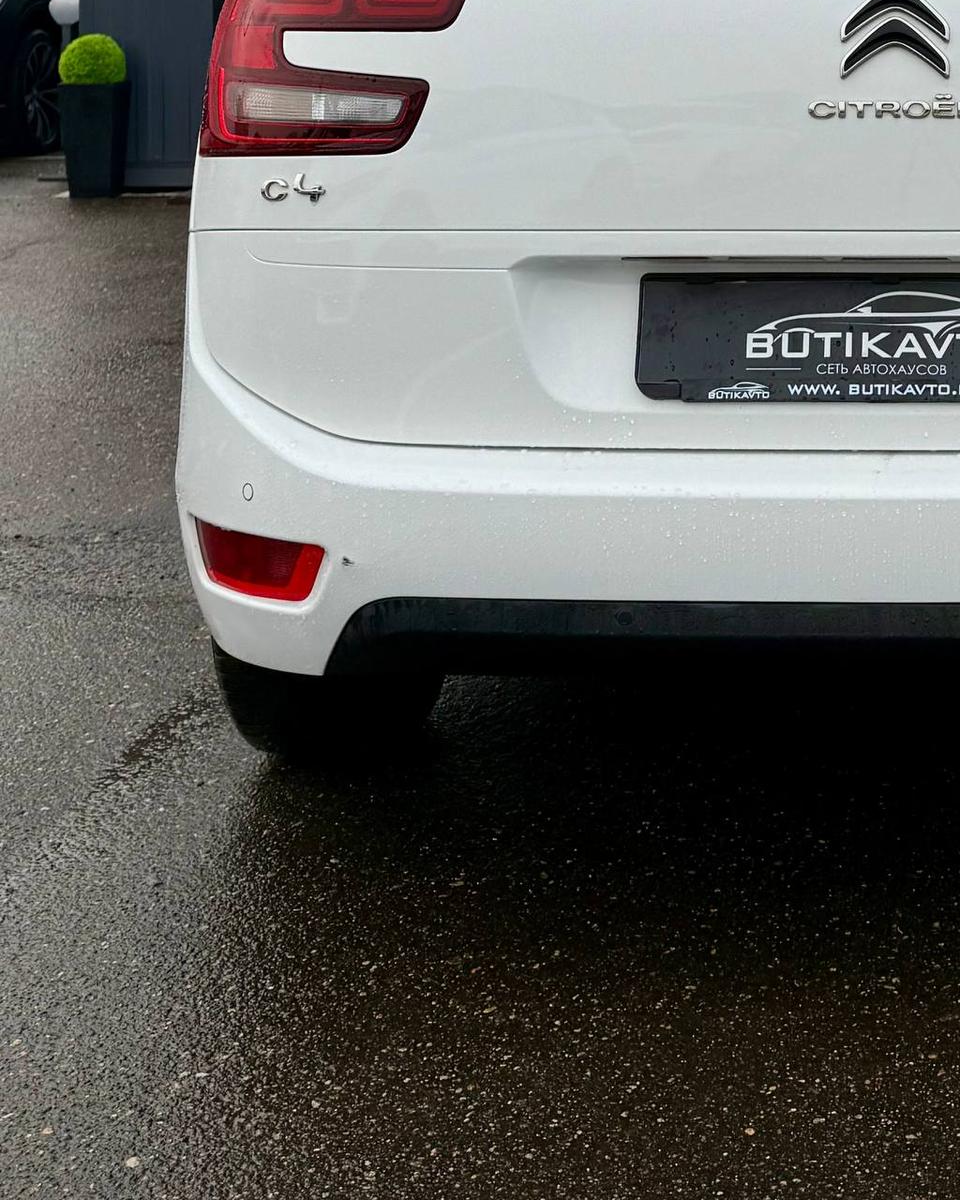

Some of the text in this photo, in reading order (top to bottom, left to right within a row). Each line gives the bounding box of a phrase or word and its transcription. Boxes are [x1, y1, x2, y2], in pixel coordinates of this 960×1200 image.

[260, 173, 326, 203] C4
[816, 363, 947, 377] СЕТЬ АВТОХАУСОВ
[708, 390, 770, 400] BUTIKAVTO
